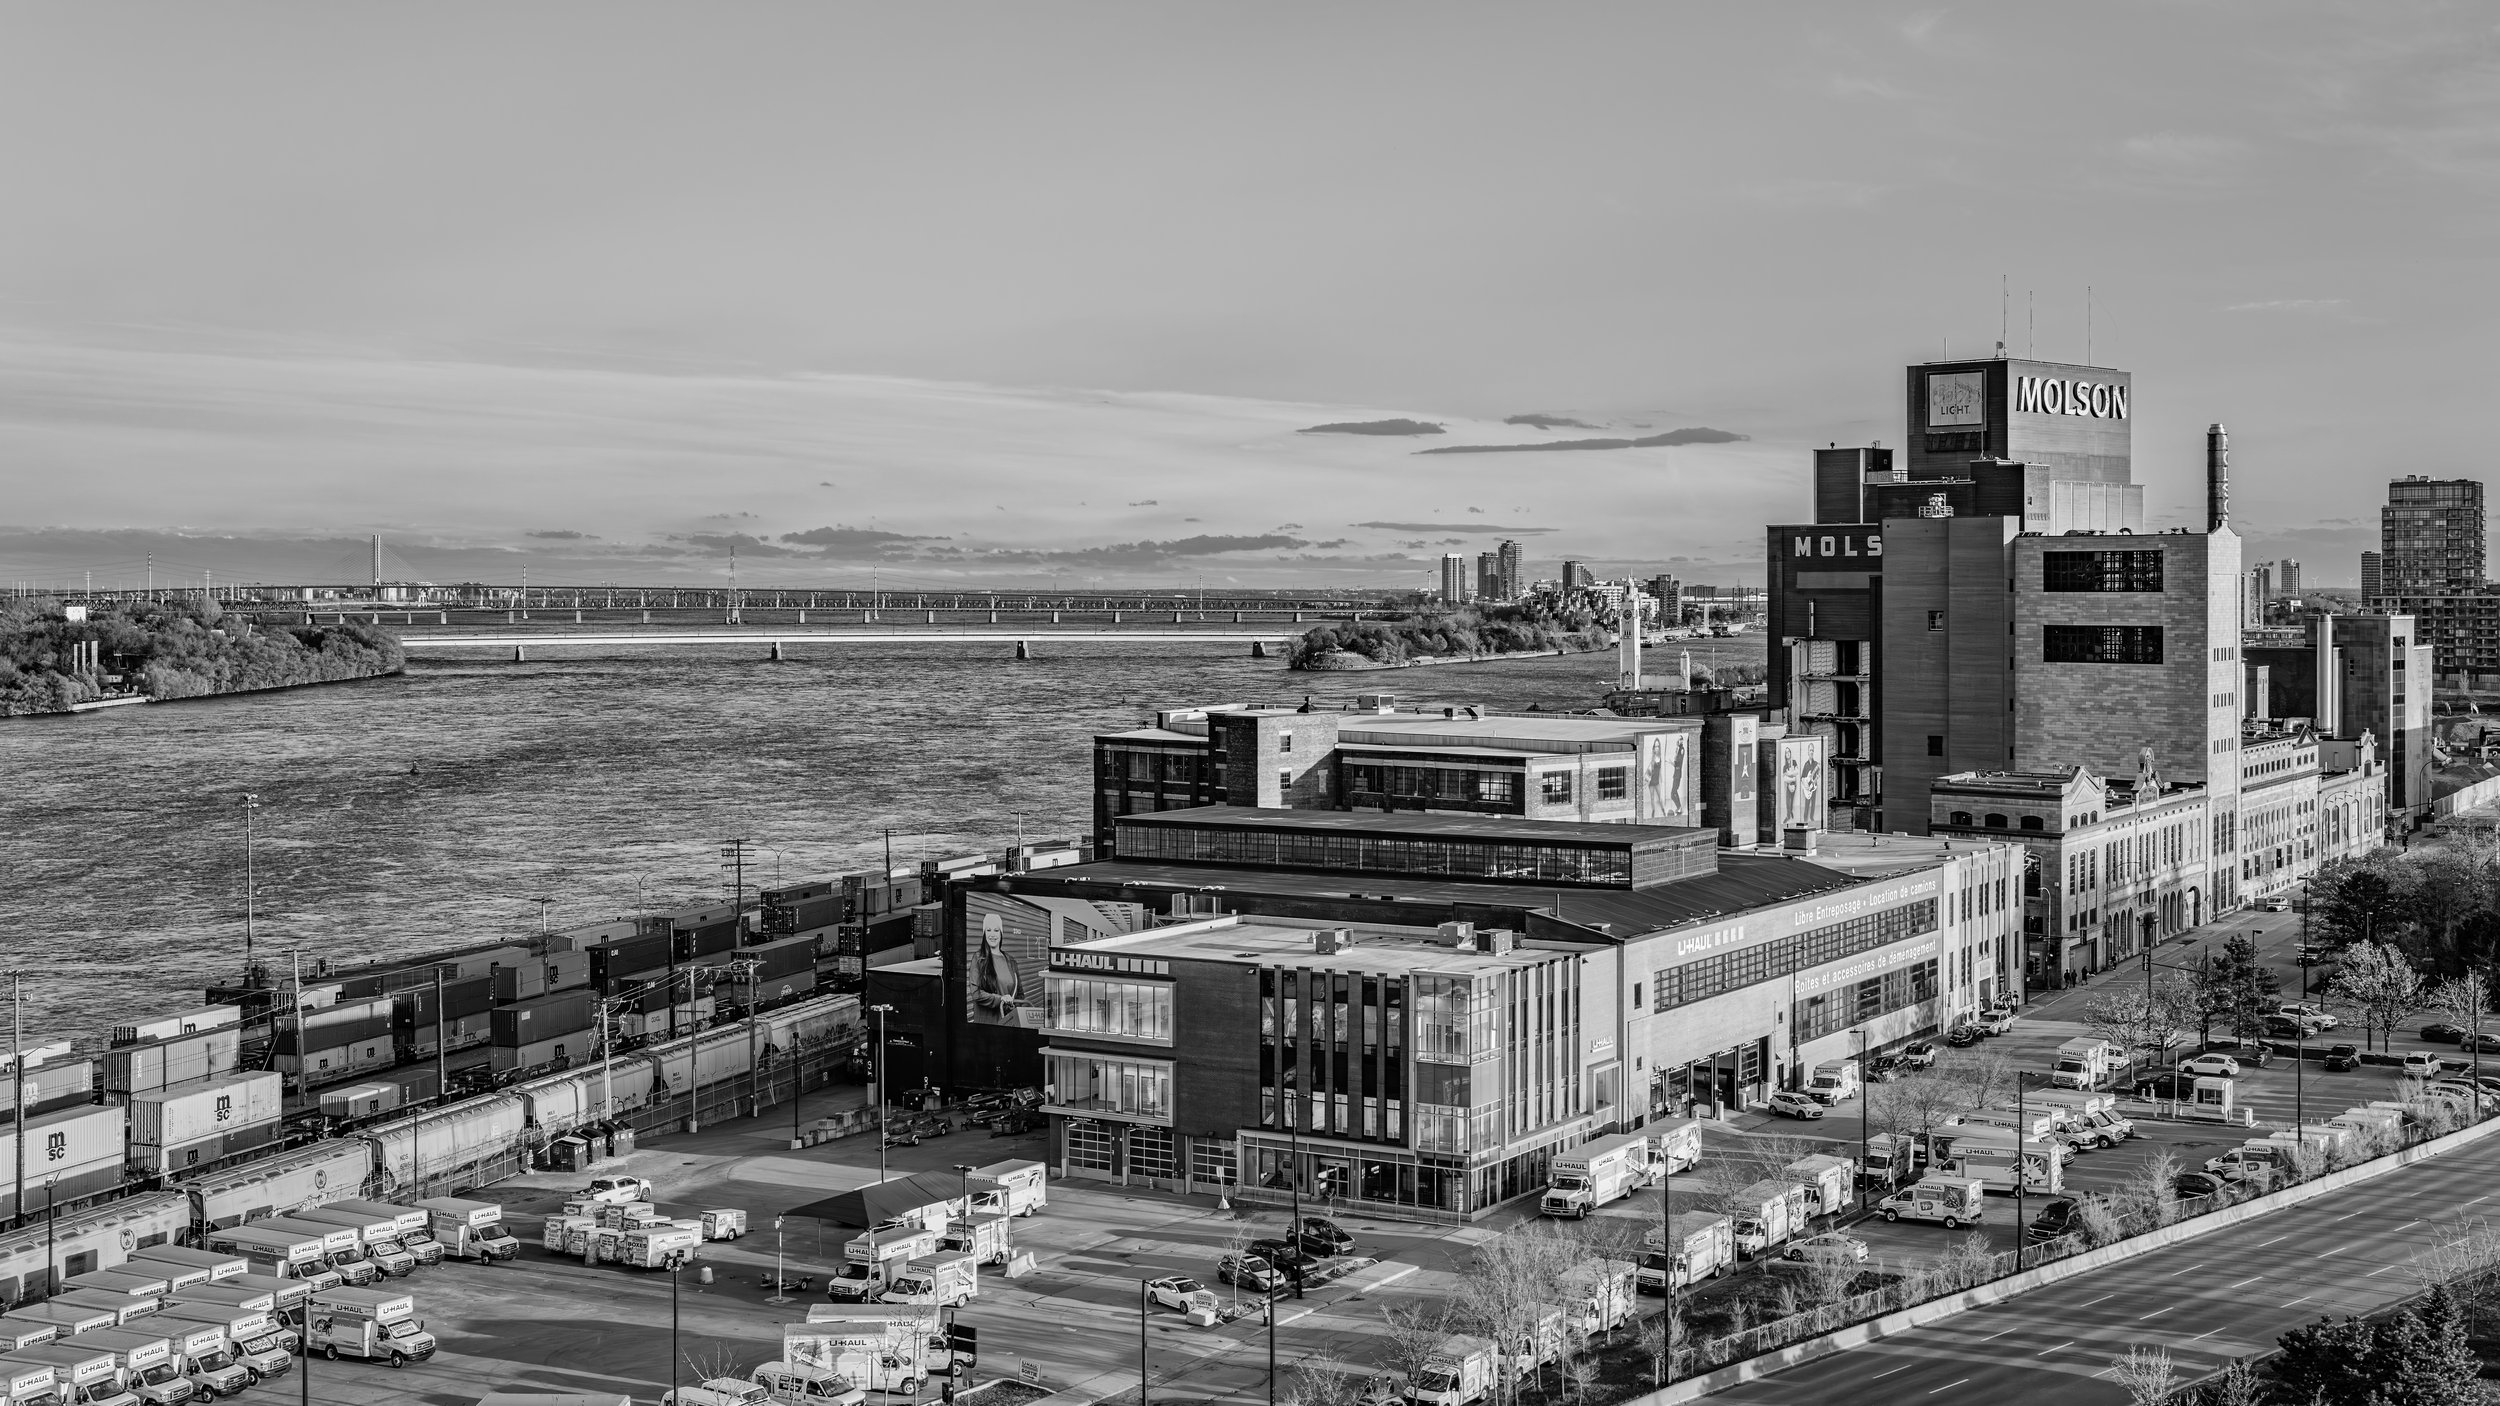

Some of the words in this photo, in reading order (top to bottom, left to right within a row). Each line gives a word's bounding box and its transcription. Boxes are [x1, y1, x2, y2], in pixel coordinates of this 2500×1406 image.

[2017, 376, 2127, 419] MOLSON
[1941, 404, 1970, 416] LIGHT
[1796, 536, 1882, 557] MOLS
[1795, 912, 1813, 926] Libre
[1816, 899, 1860, 920] Entreposage
[1870, 890, 1898, 906] Location
[1900, 886, 1908, 898] de
[1910, 880, 1936, 894] camions
[1678, 934, 1712, 956] U-HAUL
[1051, 952, 1114, 970] U-HAUL
[1822, 974, 1830, 986] et
[1832, 960, 1875, 980] accessoires
[1878, 954, 1886, 968] de
[1888, 939, 1936, 964] déménagement
[400, 1216, 424, 1224] U-HAUL
[436, 1211, 458, 1219] U-HAUL
[474, 1211, 498, 1219] U-HAUL
[370, 1226, 394, 1234] U-HAUL
[330, 1233, 354, 1242] U-HAUL
[252, 1245, 276, 1253] U-HAUL
[295, 1244, 320, 1254] U-HAUL
[218, 1265, 244, 1275] U-HAUL
[180, 1276, 206, 1287] U-HAUL
[283, 1289, 307, 1300] U-HAUL
[126, 1305, 154, 1317] U-HAUL
[337, 1304, 363, 1314] U-HAUL
[383, 1303, 409, 1314] U-HAUL
[82, 1320, 111, 1332] U-HAUL
[237, 1318, 263, 1330] U-HAUL
[24, 1333, 52, 1346] U-HAUL
[192, 1333, 220, 1346] U-HAUL
[136, 1346, 165, 1360] U-HAUL
[81, 1361, 110, 1374] U-HAUL
[19, 1374, 49, 1388] U-HAUL
